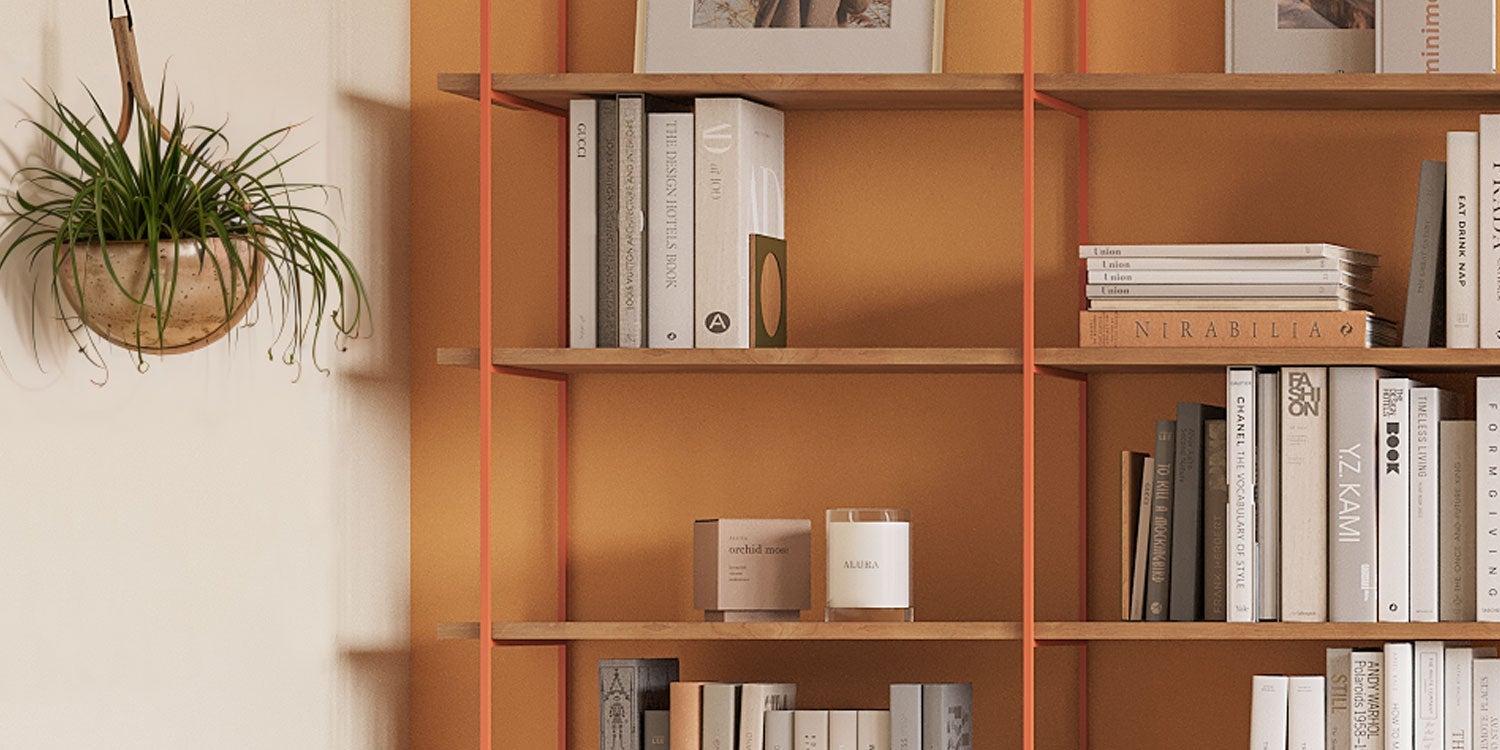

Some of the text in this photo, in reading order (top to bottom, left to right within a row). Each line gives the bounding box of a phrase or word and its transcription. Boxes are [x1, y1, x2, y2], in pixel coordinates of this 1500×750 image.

[1421, 0, 1439, 73] minim
[577, 123, 586, 158] GUCCI
[665, 120, 677, 288] THE DESIGN HOTELS BOOK
[1458, 196, 1466, 287] EAT DRINK NAP
[1418, 396, 1427, 442] TIMELESS
[1157, 463, 1170, 475] TO
[1386, 422, 1400, 475] BOOK
[1418, 446, 1427, 478] LIVING
[1155, 480, 1170, 500] KILL
[1236, 396, 1245, 589] CHANEL THE VOCABULARY OF STYLE
[1338, 443, 1361, 542] Y.Z. KAMI
[1488, 402, 1498, 597] FORMGIVING
[728, 543, 762, 555] orchid
[1454, 521, 1462, 543] AND
[1331, 674, 1347, 714] STILL
[1354, 660, 1367, 708] Polaroids
[1367, 661, 1380, 739] ANDY WARHOL
[1391, 703, 1400, 726] HOW
[1391, 727, 1400, 739] TO
